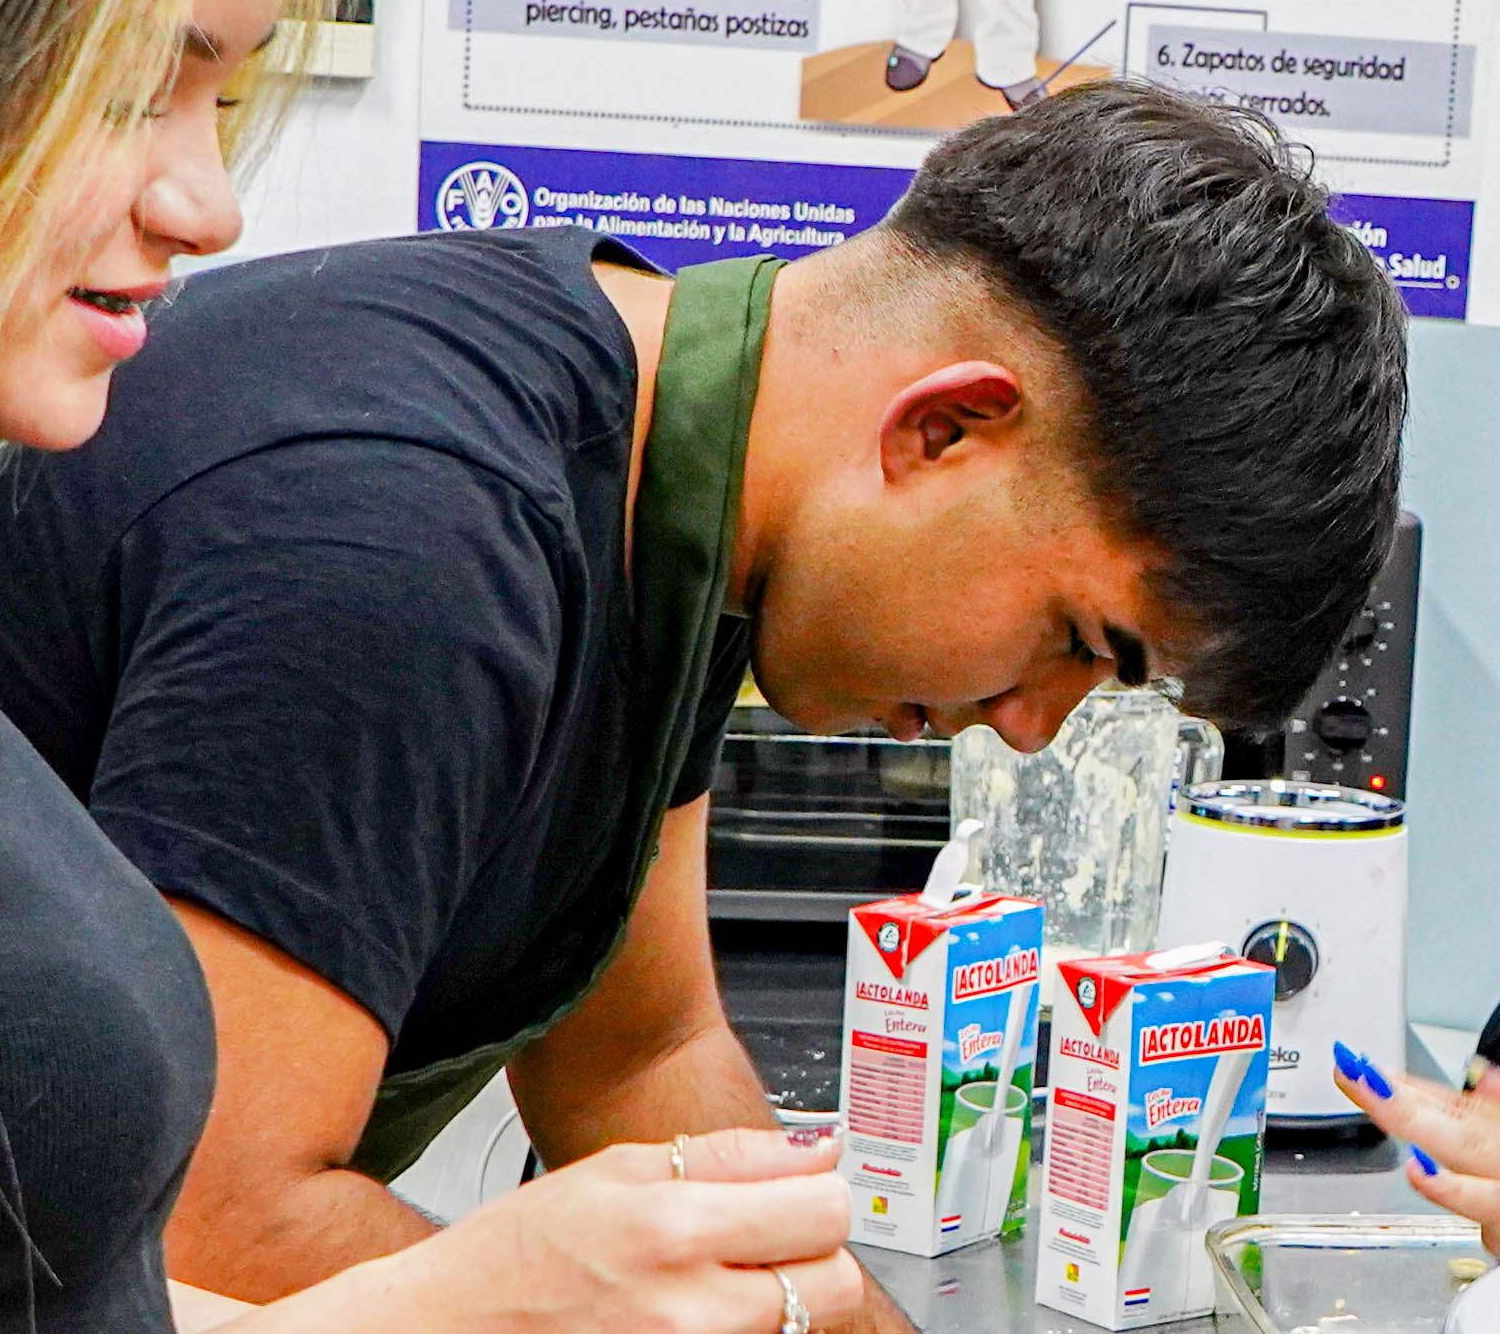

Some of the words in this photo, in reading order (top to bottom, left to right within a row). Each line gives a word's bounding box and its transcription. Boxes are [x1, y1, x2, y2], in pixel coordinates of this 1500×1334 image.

[533, 186, 651, 213] Organización
[651, 193, 677, 215] de
[678, 194, 707, 216] las
[708, 196, 791, 221] Naciones
[793, 201, 856, 225] Unidas
[1391, 254, 1446, 279] Salud
[955, 951, 1038, 999] LACTOLANDA
[856, 981, 930, 1009] LACTOLANDA
[885, 1017, 927, 1034] Entera
[962, 1034, 1001, 1060] Entera
[1060, 1037, 1121, 1070] LACTOLANDA
[1143, 1018, 1263, 1062] LACTOLANDA
[1087, 1075, 1117, 1095] Entera
[1150, 1099, 1199, 1126] Entera
